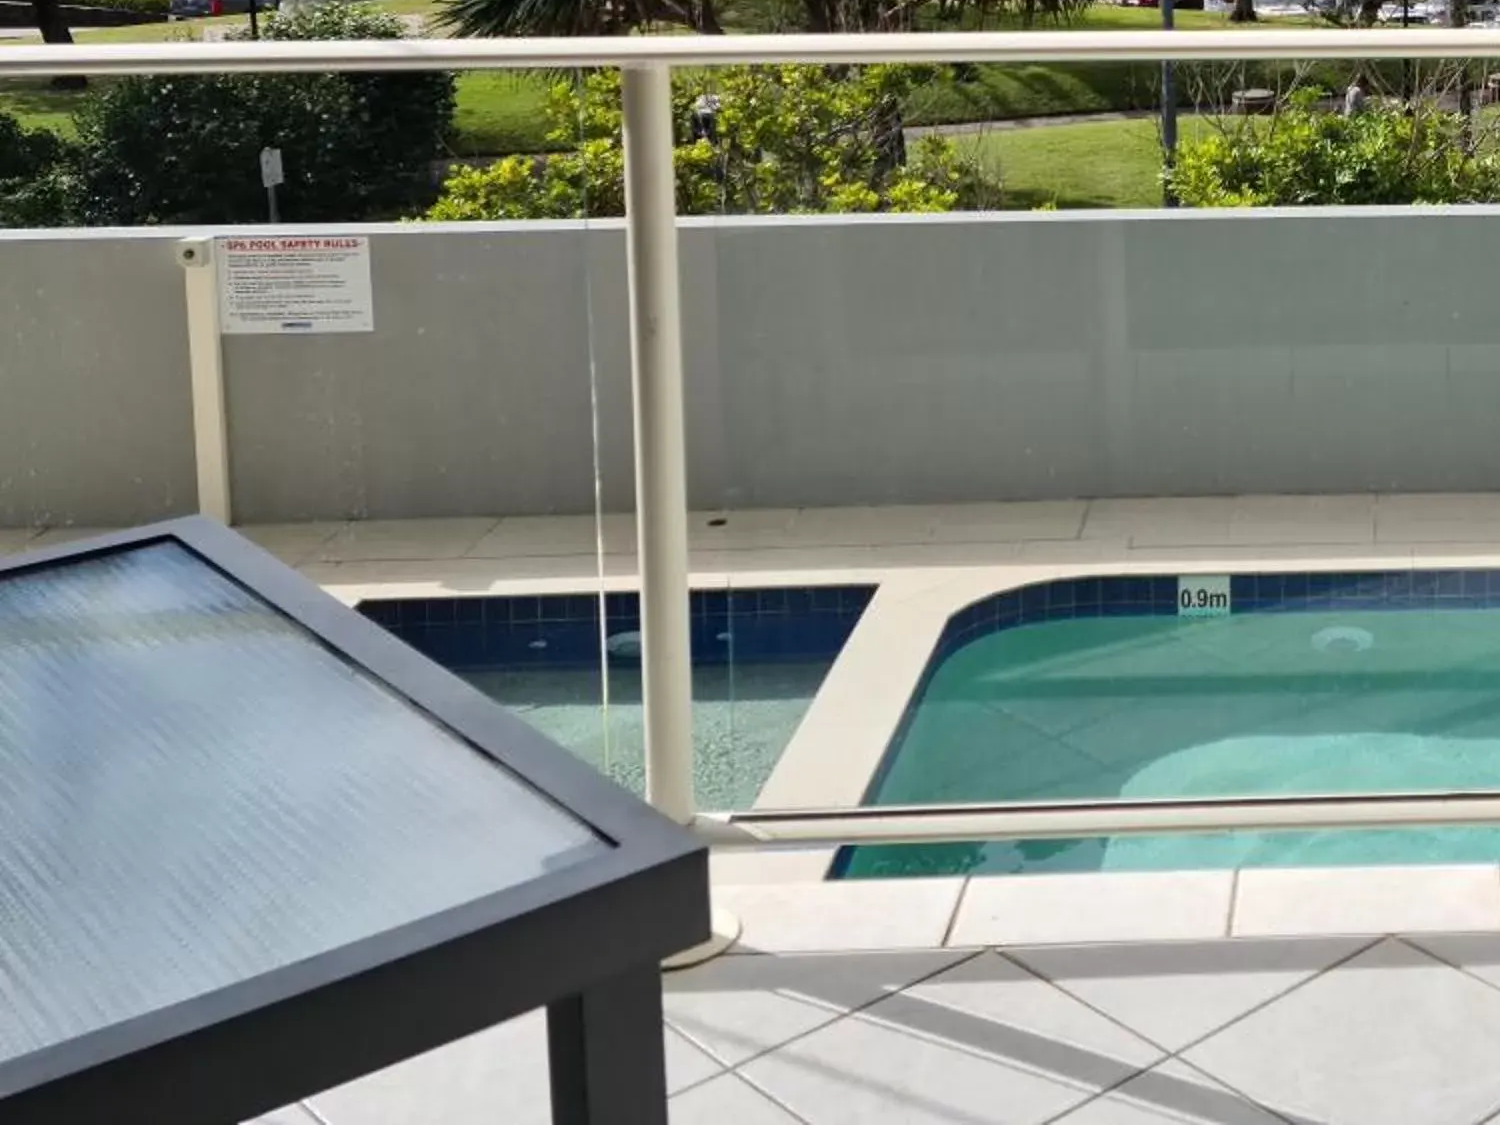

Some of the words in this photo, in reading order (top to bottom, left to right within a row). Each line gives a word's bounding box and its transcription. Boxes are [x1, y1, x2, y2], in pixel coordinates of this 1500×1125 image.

[226, 241, 246, 250] SPA
[249, 240, 275, 250] POOL
[281, 240, 320, 249] SAFETY
[323, 239, 358, 248] RULES
[1181, 588, 1227, 608] 0.9m
